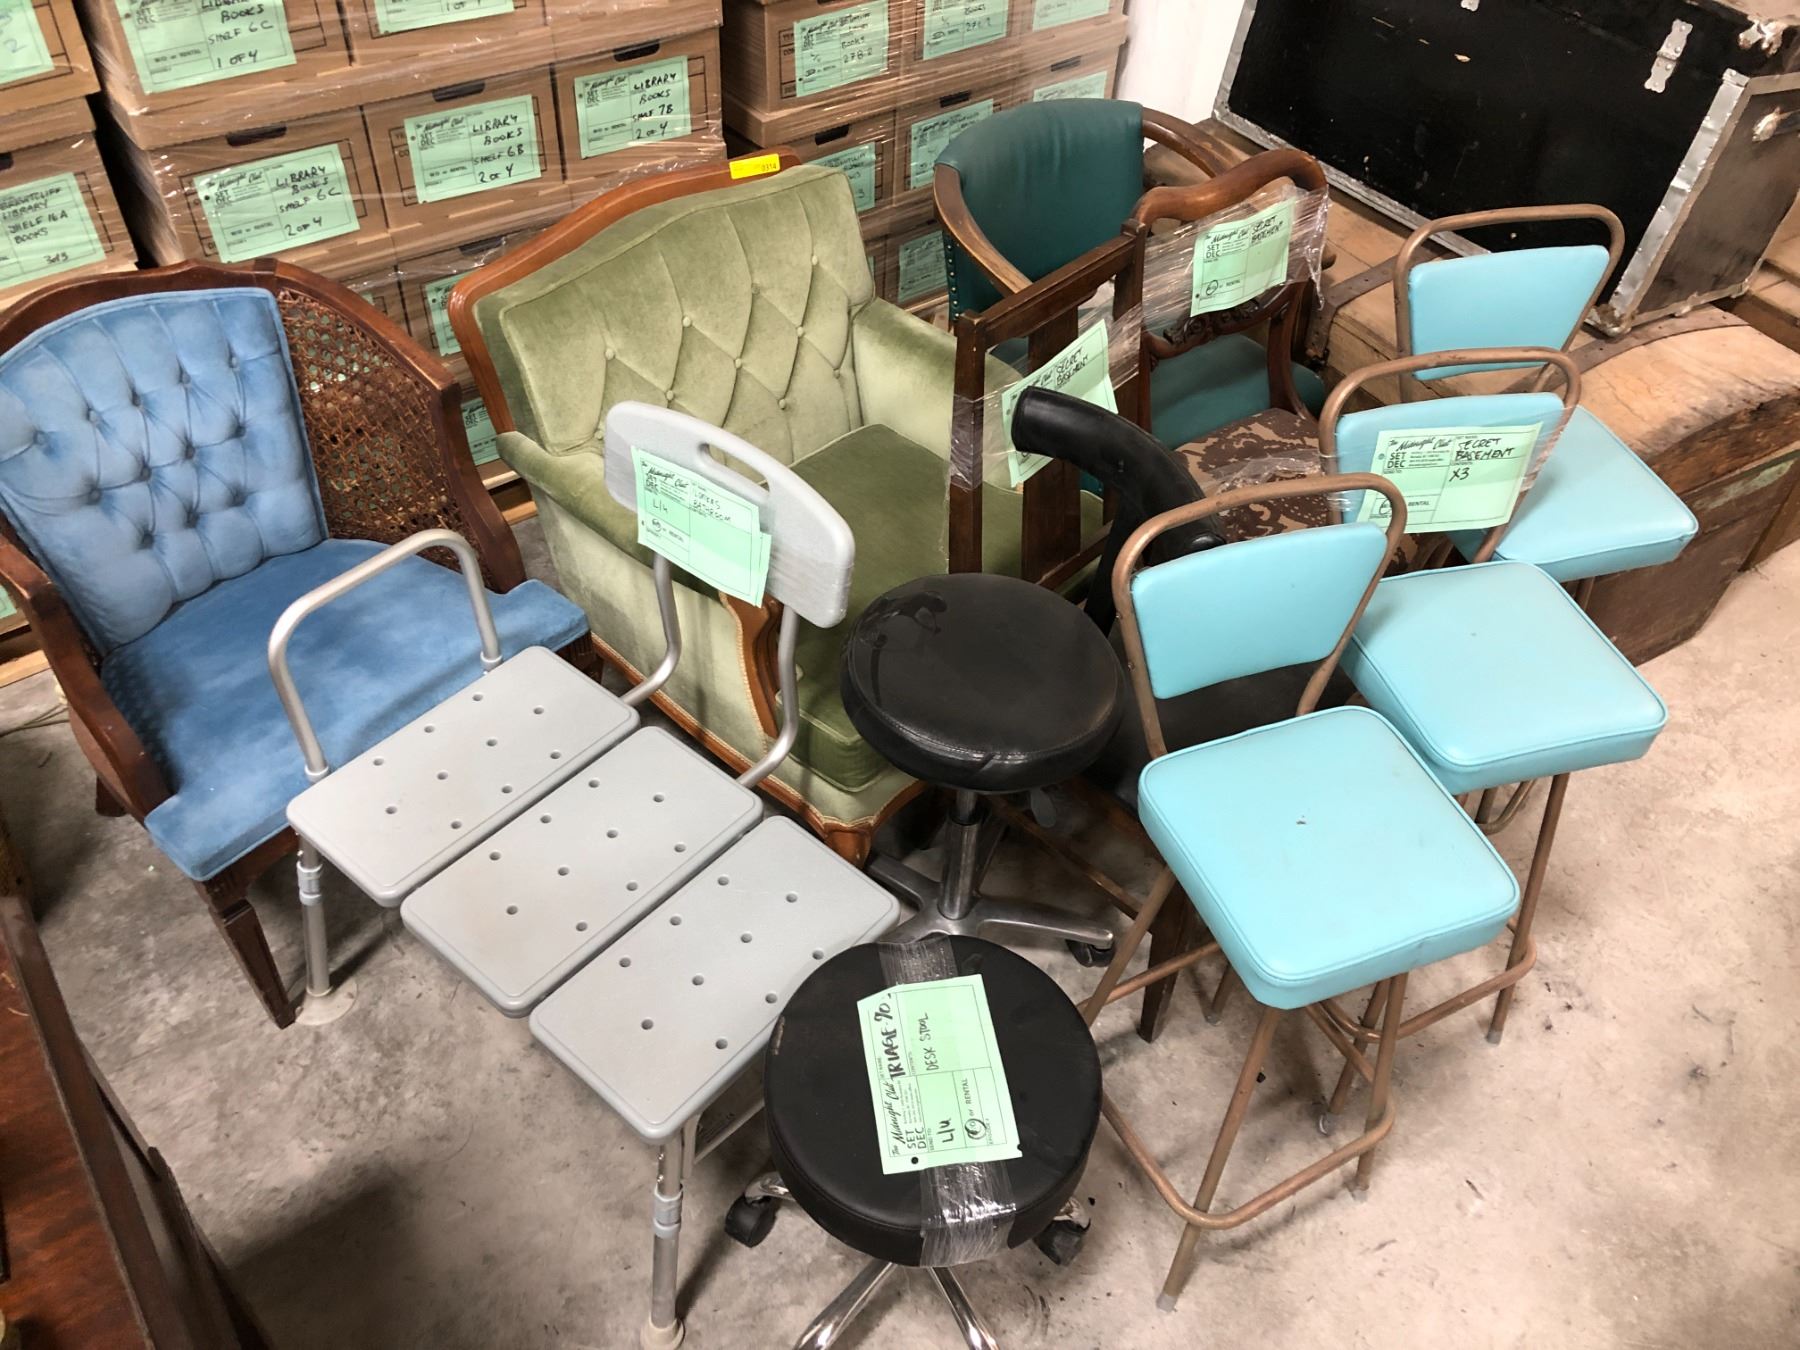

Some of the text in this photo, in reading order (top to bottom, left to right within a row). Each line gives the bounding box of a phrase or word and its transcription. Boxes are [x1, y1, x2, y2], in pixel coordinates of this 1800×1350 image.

[633, 72, 677, 90] LIBRARY
[472, 114, 518, 133] LIBRARY
[483, 128, 523, 146] BOOKS
[275, 165, 326, 188] LIBRARY
[478, 171, 488, 183] 2
[284, 224, 297, 237] 2
[1206, 251, 1220, 259] DEC
[1390, 451, 1407, 460] SET
[1454, 447, 1515, 461] BASEMENT
[1387, 460, 1406, 468] DEC
[918, 1012, 939, 1071] DESK STOOL
[882, 1081, 900, 1101] Club
[962, 1077, 972, 1105] RENTAL
[884, 1101, 906, 1145] Midnight
[905, 1129, 916, 1149] SET
[914, 1127, 927, 1149] DEC
